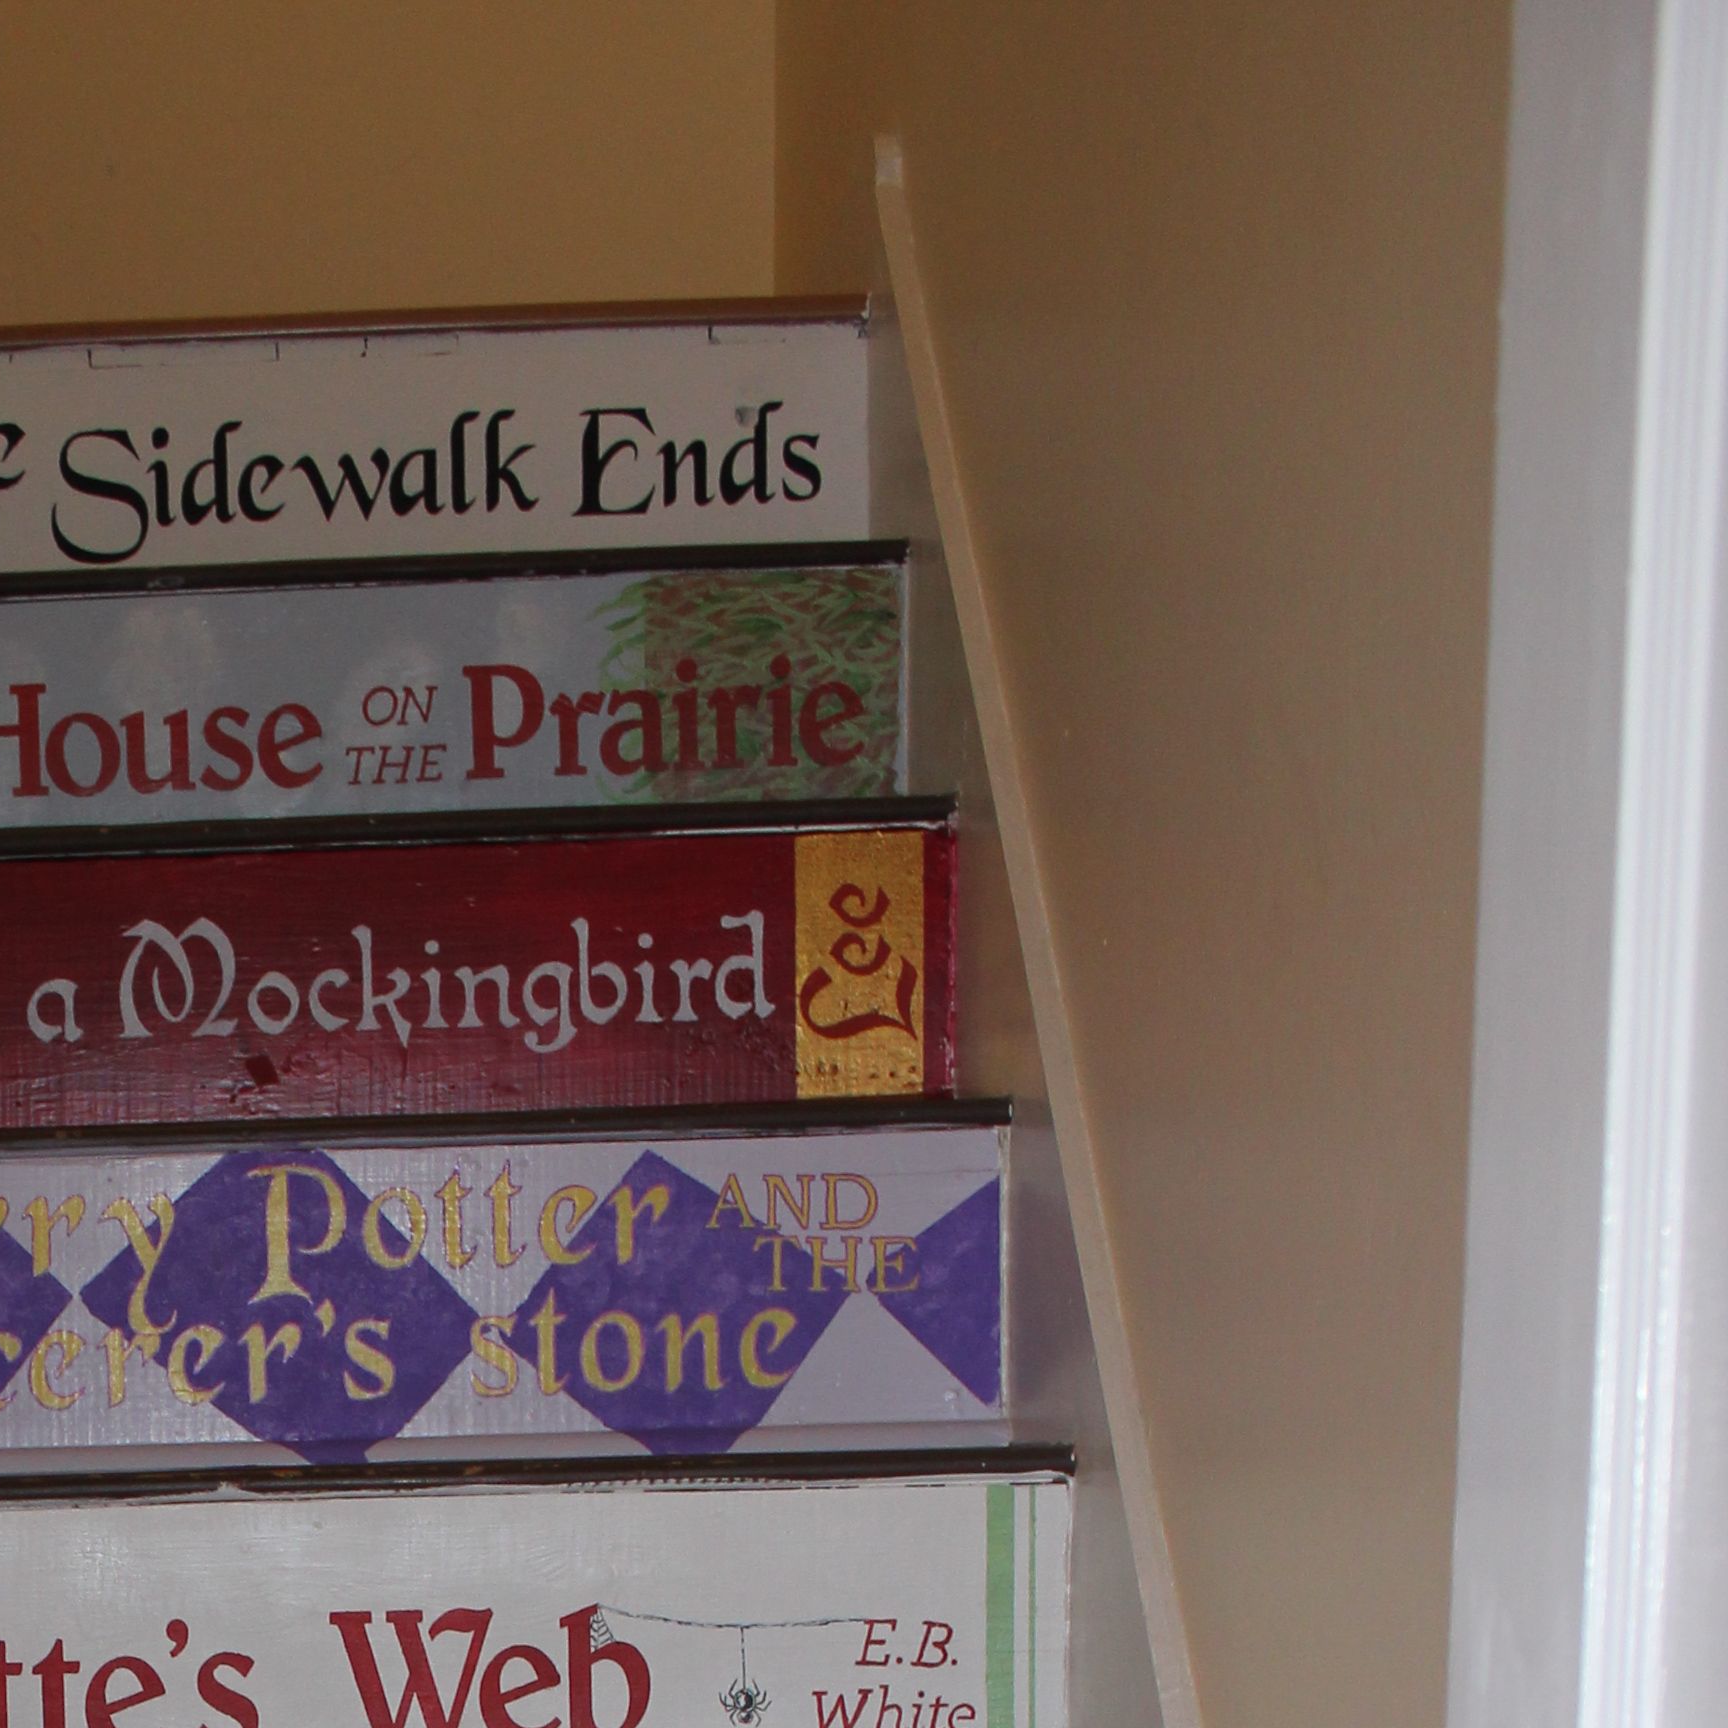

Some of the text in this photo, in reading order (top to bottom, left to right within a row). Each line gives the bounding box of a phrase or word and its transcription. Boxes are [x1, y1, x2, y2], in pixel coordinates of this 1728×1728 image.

[51, 409, 539, 563] Sidewalk
[572, 400, 822, 517] Ends
[361, 684, 439, 730] ON
[461, 658, 865, 781] Prairie
[344, 744, 448, 786] THE
[27, 978, 84, 1042] a
[117, 910, 777, 1054] Mockingbird
[797, 881, 920, 1044] Lee
[247, 1161, 671, 1306] Potter
[707, 1171, 881, 1234] AND
[755, 1235, 922, 1294] THE
[470, 1287, 801, 1399] stone
[857, 1618, 961, 1671] E.B.
